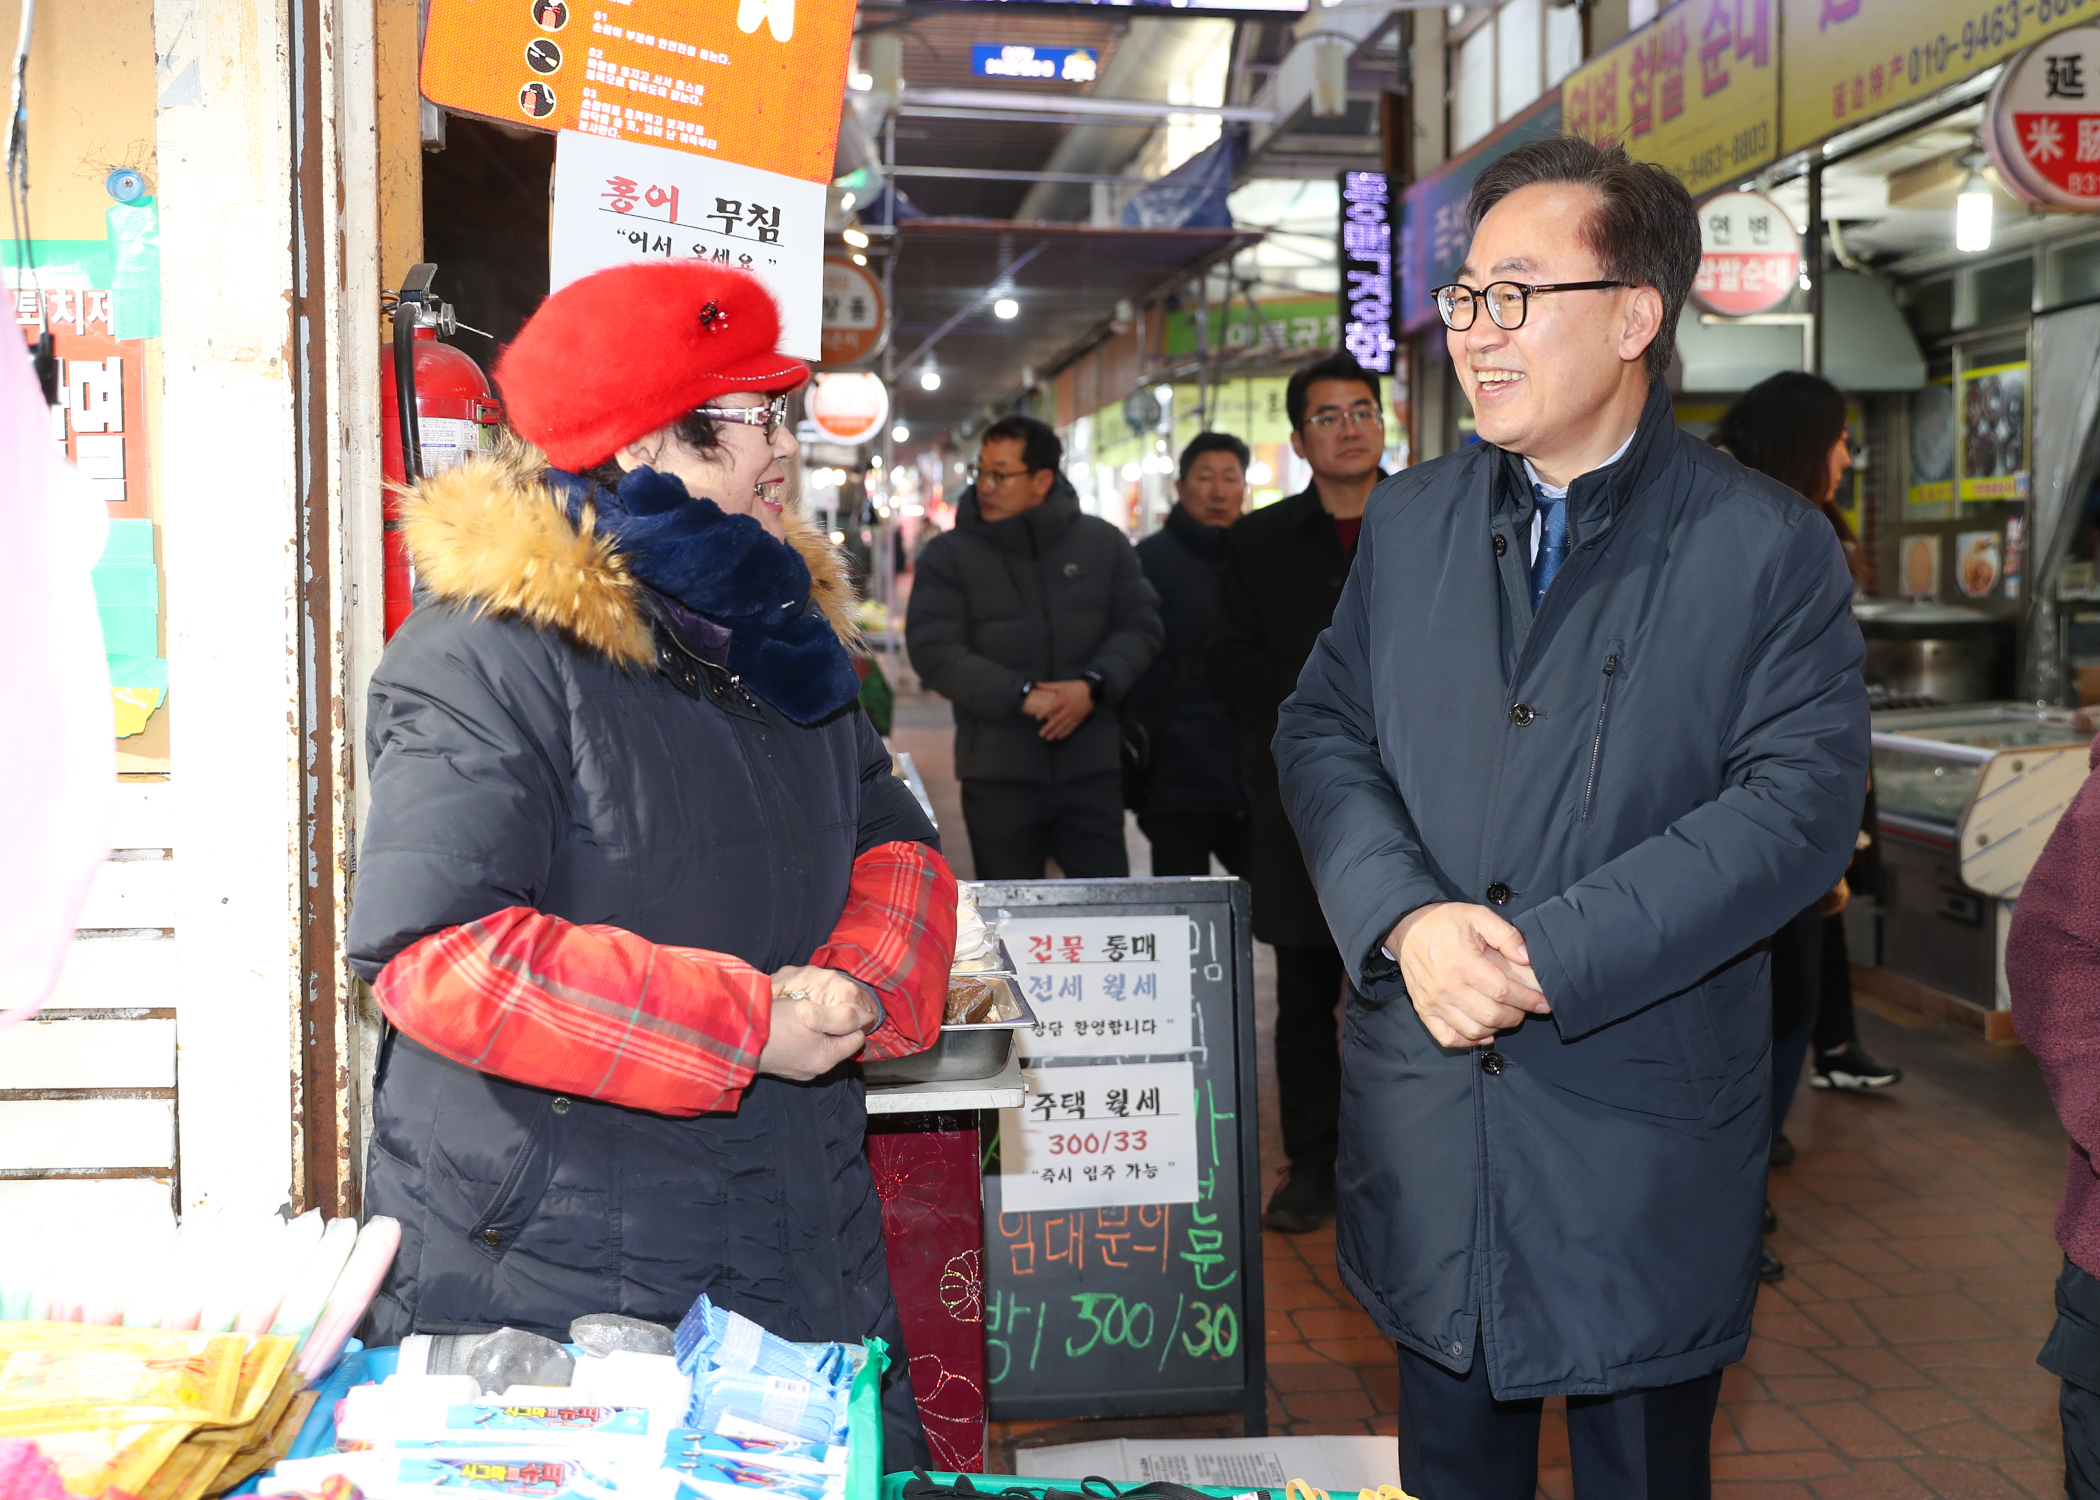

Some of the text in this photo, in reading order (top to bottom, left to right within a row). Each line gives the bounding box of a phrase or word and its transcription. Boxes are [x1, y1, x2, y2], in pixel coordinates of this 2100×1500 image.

[593, 10, 608, 22] 01
[592, 22, 623, 38] 손잡이
[588, 47, 603, 59] 02
[620, 65, 651, 82] 등지고
[652, 74, 673, 88] 서서
[582, 87, 598, 99] 03
[581, 99, 621, 117] 손잡이를
[601, 175, 781, 243] 홍어 무침
[1028, 932, 1157, 963] 건물 통매
[1030, 1086, 1162, 1122] 주택 월세
[1049, 1129, 1148, 1155] 300/33
[1083, 1165, 1116, 1183] 입주
